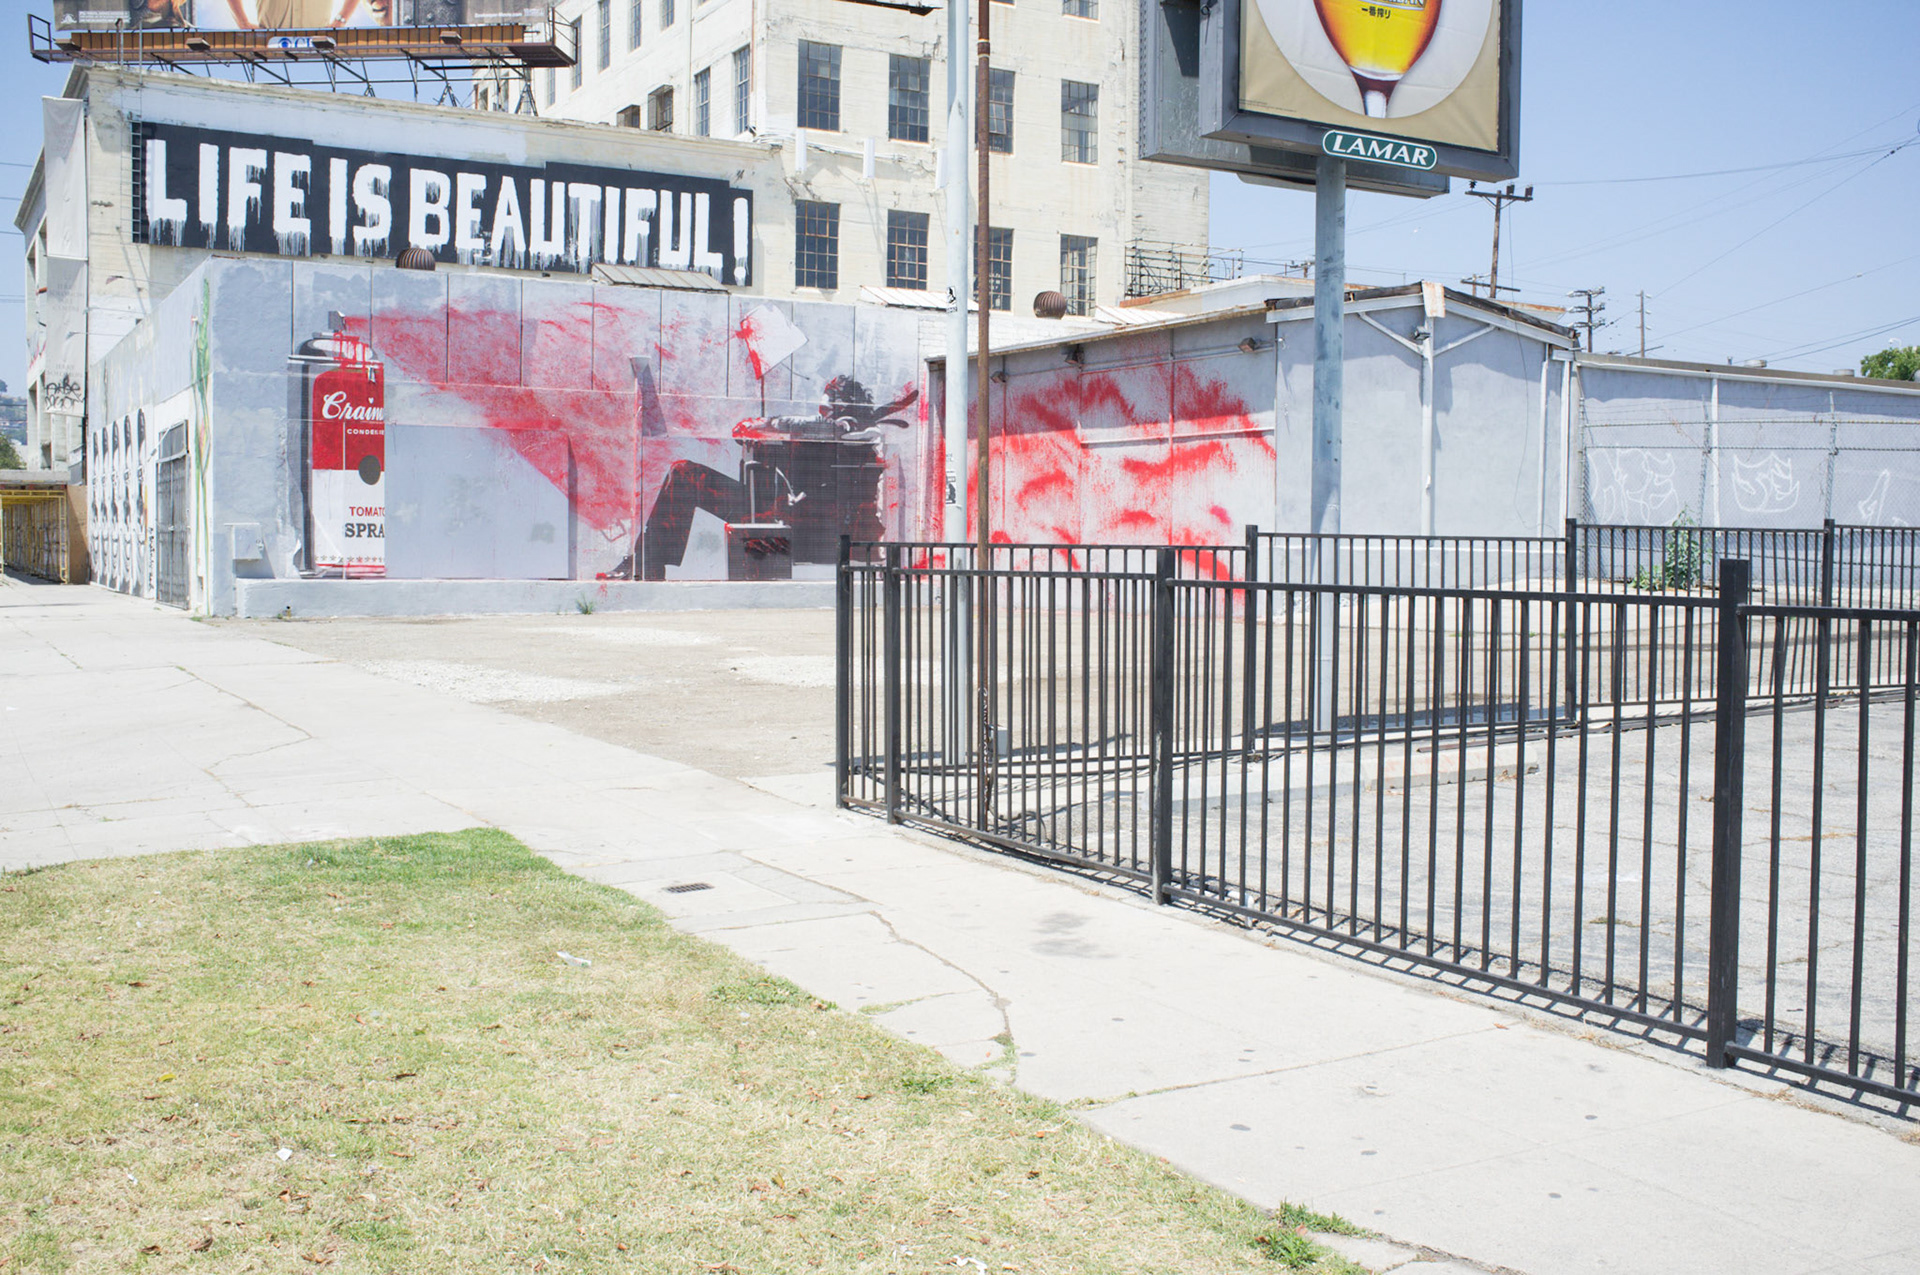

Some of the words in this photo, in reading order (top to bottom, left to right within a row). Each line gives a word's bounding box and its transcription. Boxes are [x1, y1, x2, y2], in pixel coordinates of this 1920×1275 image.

[1332, 134, 1429, 166] LAMAR
[145, 138, 312, 255] LIFE
[328, 156, 392, 255] IS
